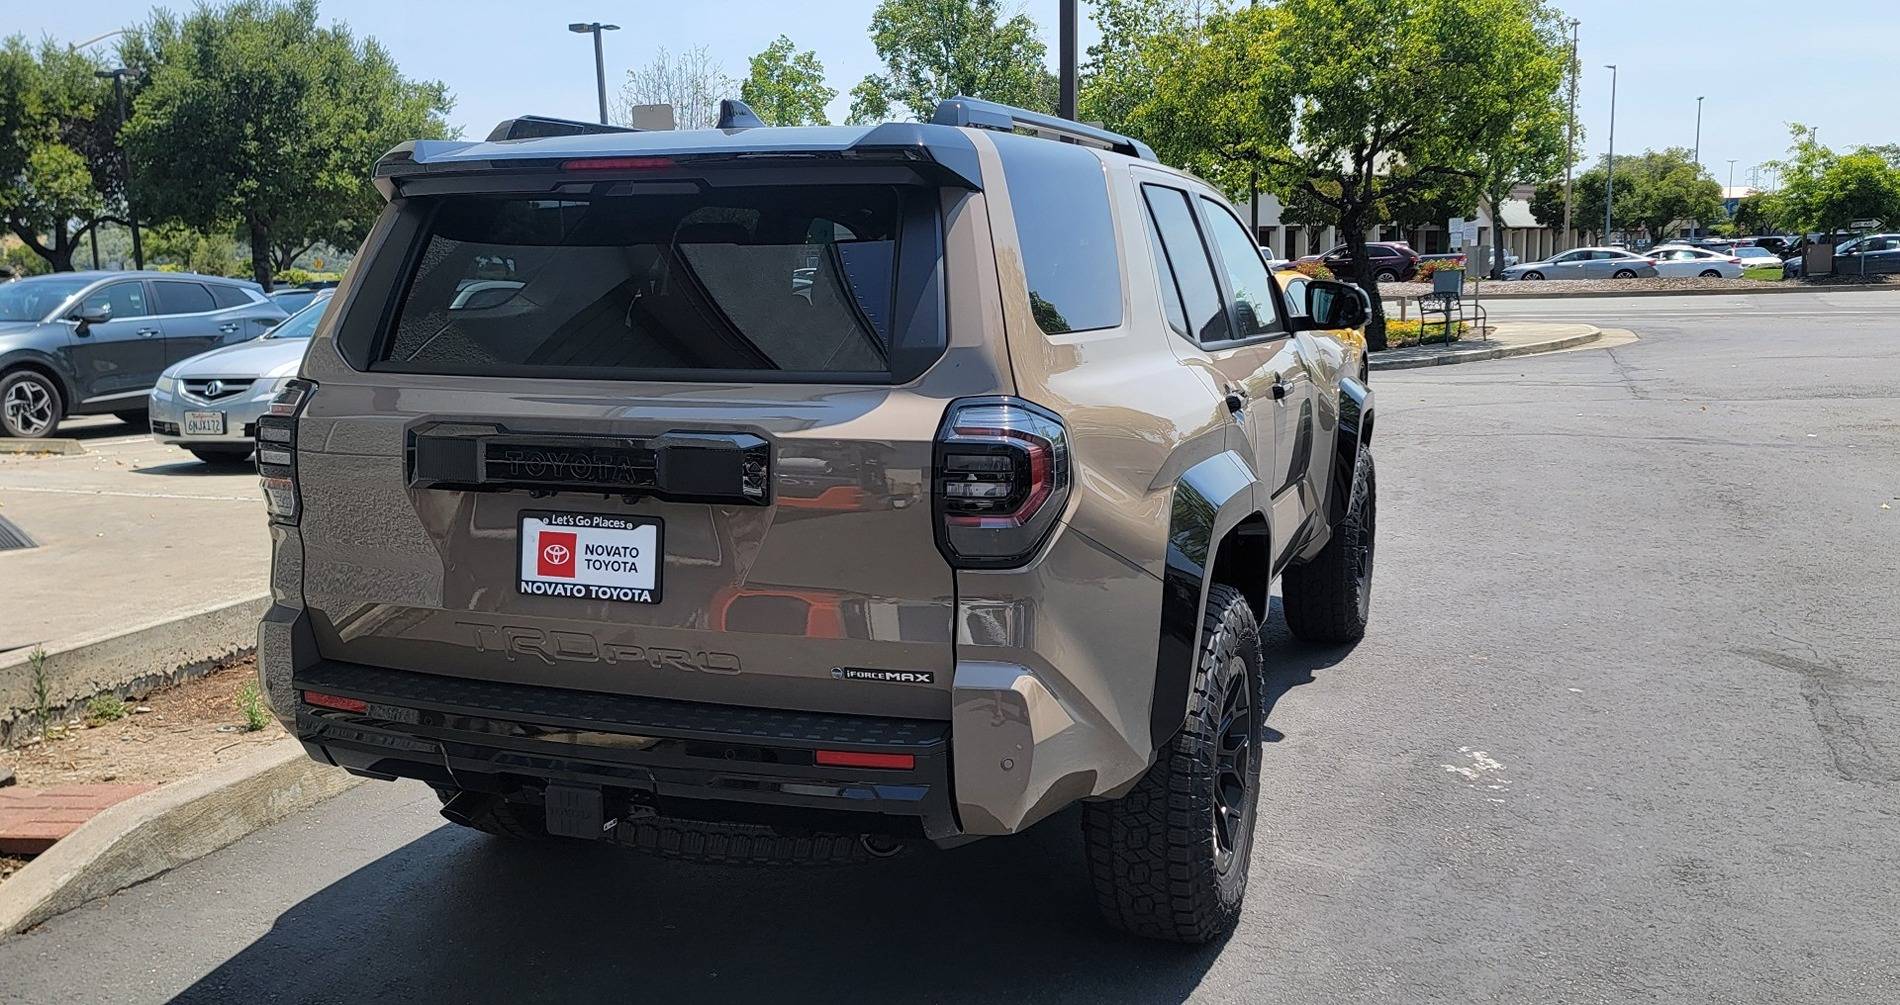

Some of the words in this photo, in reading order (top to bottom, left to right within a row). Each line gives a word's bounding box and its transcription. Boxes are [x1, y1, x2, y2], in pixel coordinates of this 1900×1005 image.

[189, 419, 220, 432] 6NJX172
[505, 450, 636, 484] TOYOTA
[552, 514, 574, 526] Let's
[576, 515, 591, 527] Go
[593, 516, 625, 529] Places
[585, 544, 640, 559] NOVATO
[585, 559, 638, 574] TOYOTA
[521, 581, 586, 598] NOVATO
[590, 586, 652, 603] TOYOTA
[455, 621, 599, 666] TRD
[602, 642, 742, 676] PRO
